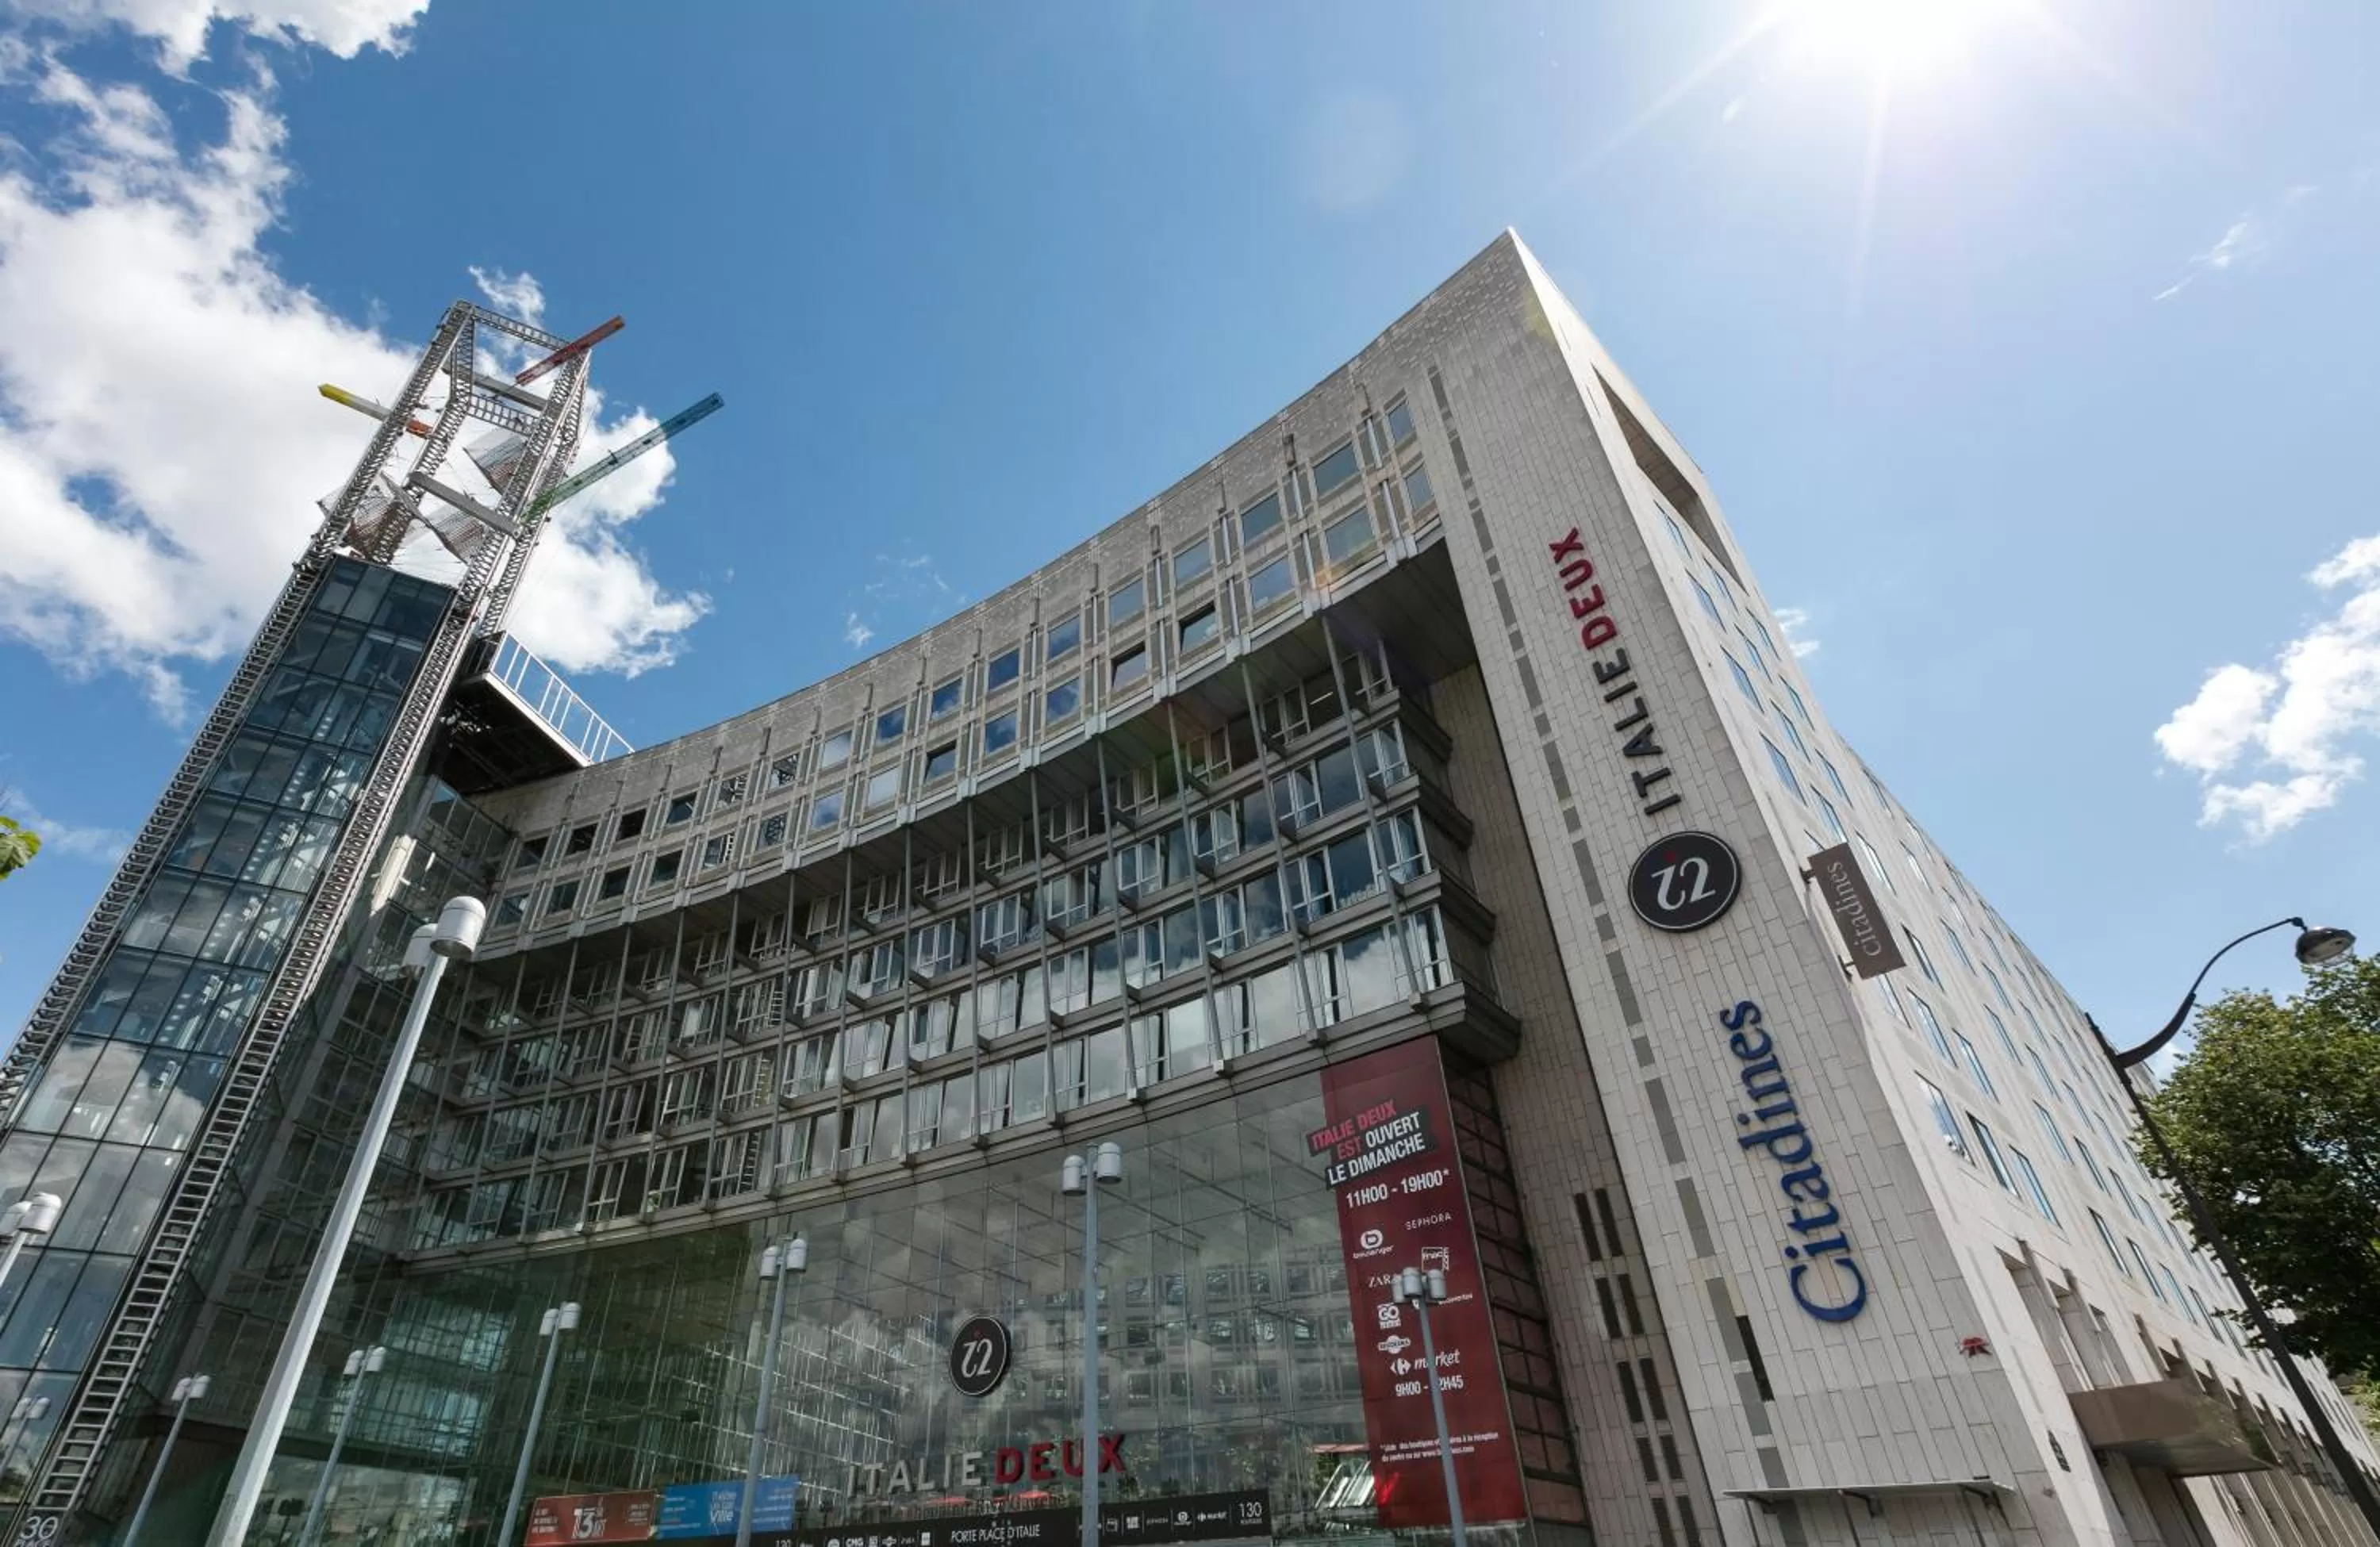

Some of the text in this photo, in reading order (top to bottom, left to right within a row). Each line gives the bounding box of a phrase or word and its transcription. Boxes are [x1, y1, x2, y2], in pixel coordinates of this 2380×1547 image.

[1549, 528, 1681, 816] ITALIE DEUX
[1312, 1100, 1396, 1150] ITALIE DEUX
[1338, 1111, 1420, 1160] EST OUVERT
[1327, 1133, 1426, 1185] LE DIMANCHE
[1720, 1000, 1867, 1322] Citadines
[1346, 1184, 1388, 1208] 11H00
[1405, 1211, 1452, 1230] SEPHORA
[1368, 1274, 1393, 1288] ZAR
[1395, 1381, 1421, 1397] 9H00
[846, 1433, 1127, 1498] ITALIE DEUX
[1238, 1502, 1262, 1518] 130
[20, 1516, 59, 1539] 30
[951, 1529, 977, 1543] PORTE
[979, 1527, 1005, 1541] PLACE
